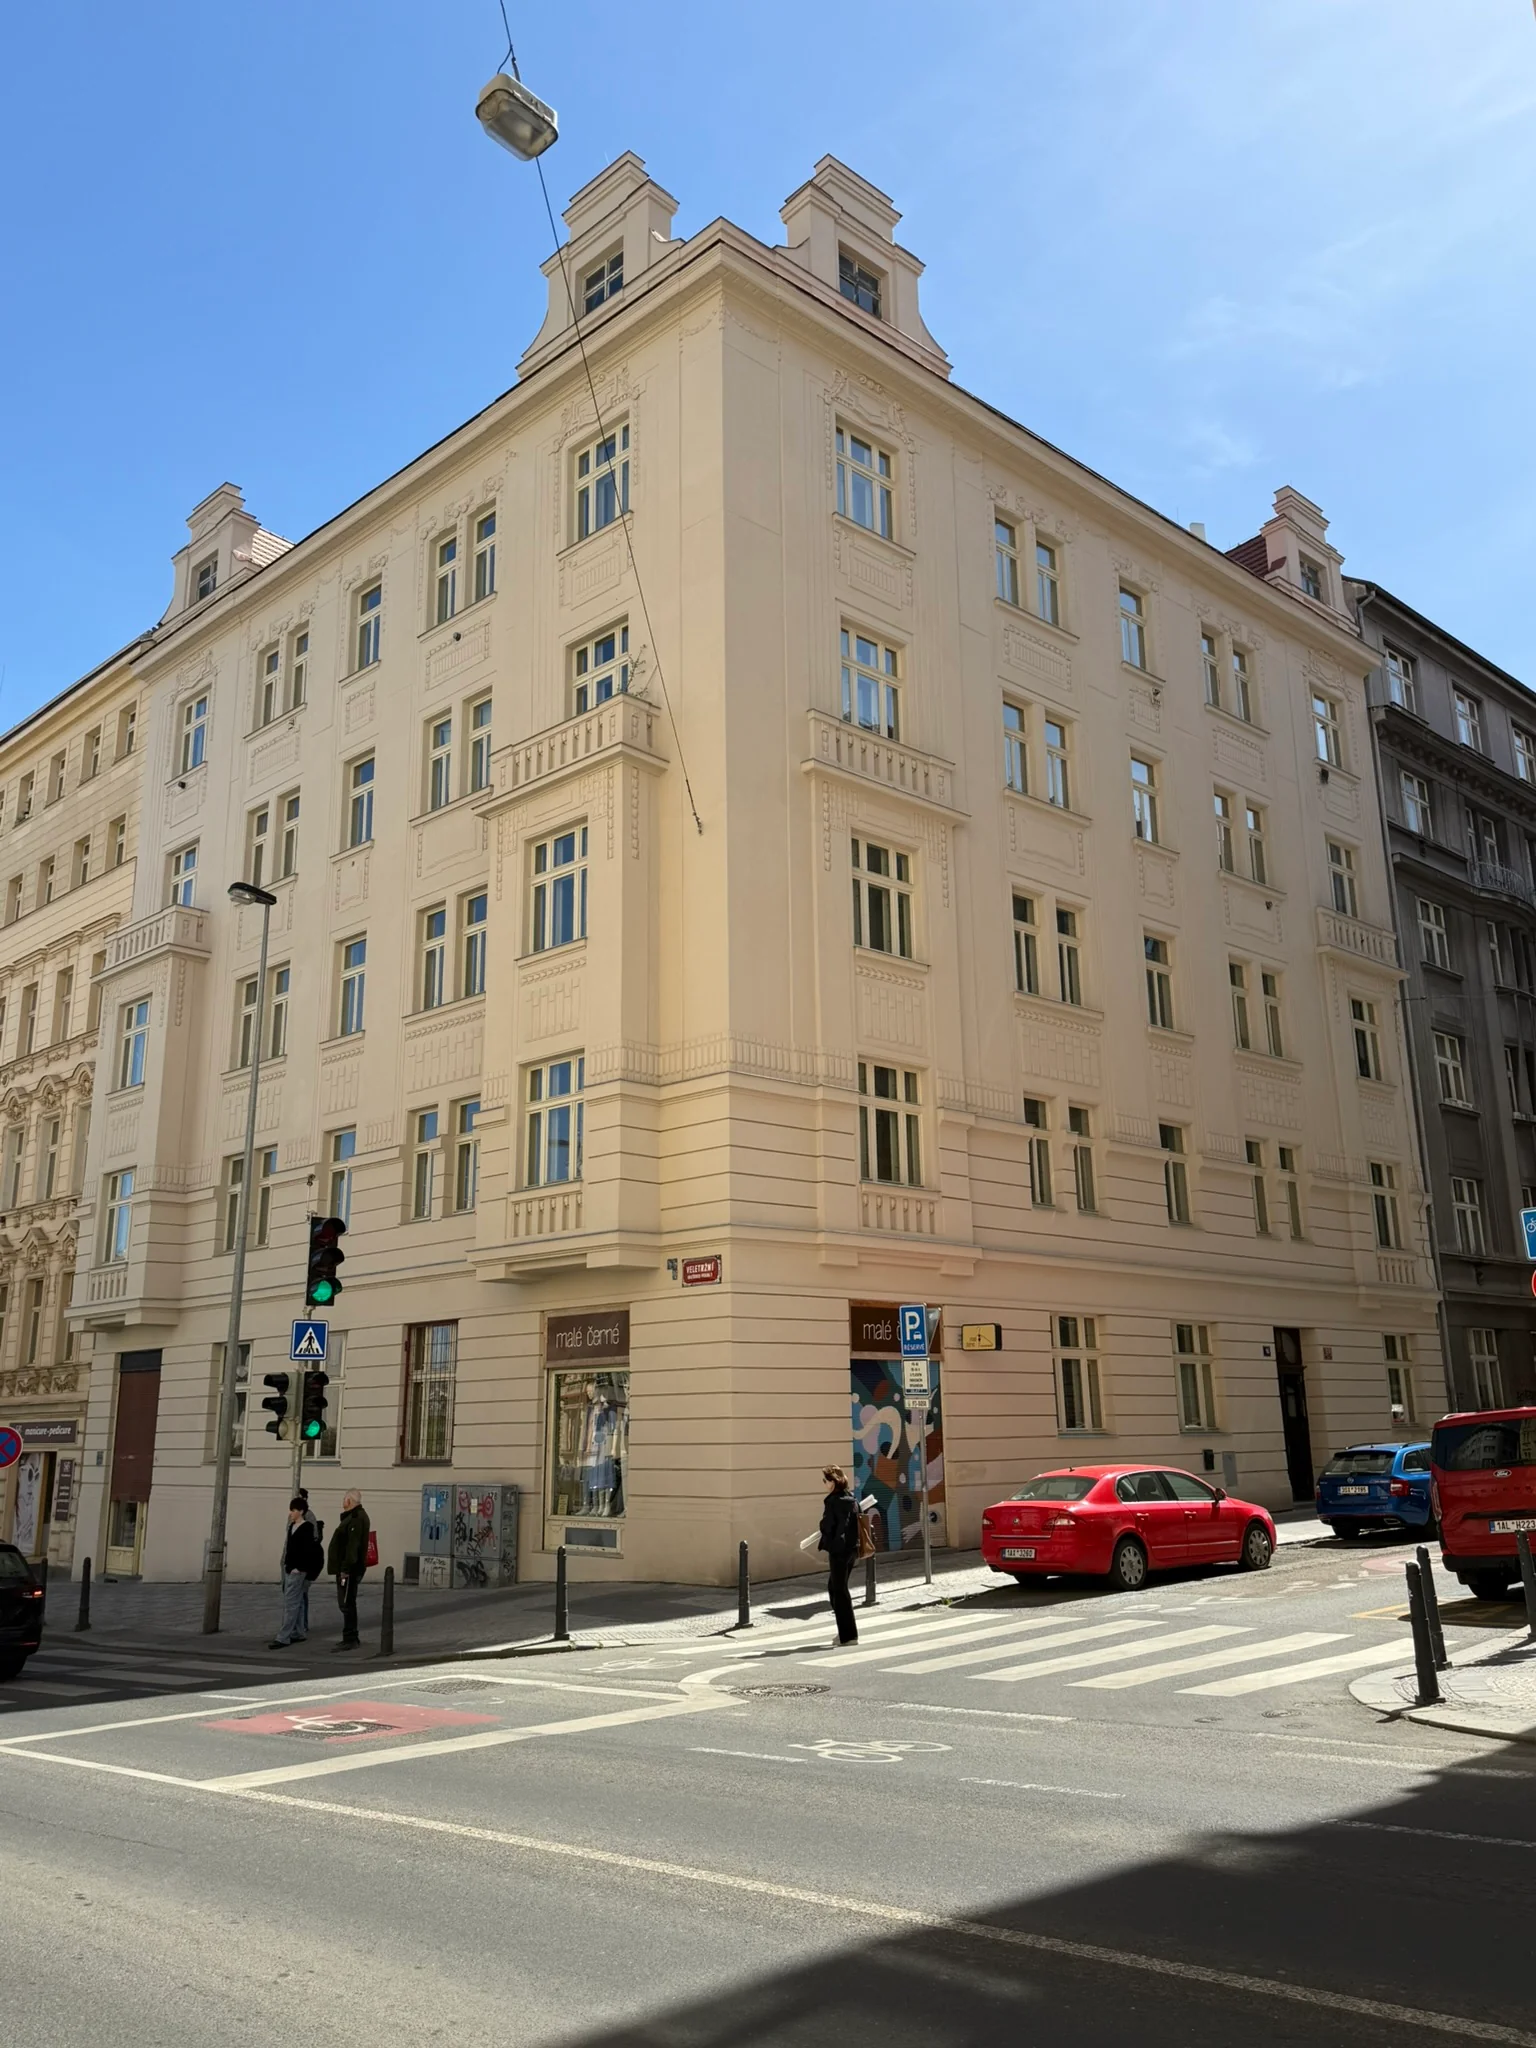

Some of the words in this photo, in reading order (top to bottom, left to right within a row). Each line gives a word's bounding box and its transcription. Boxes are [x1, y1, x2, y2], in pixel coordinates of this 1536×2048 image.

[686, 1261, 715, 1273] VELETRŽNÍ
[555, 1326, 583, 1348] malé
[586, 1323, 620, 1347] černé
[863, 1320, 892, 1341] malé
[904, 1311, 921, 1341] P
[1496, 1521, 1511, 1530] 1AL
[1515, 1520, 1536, 1529] H223
